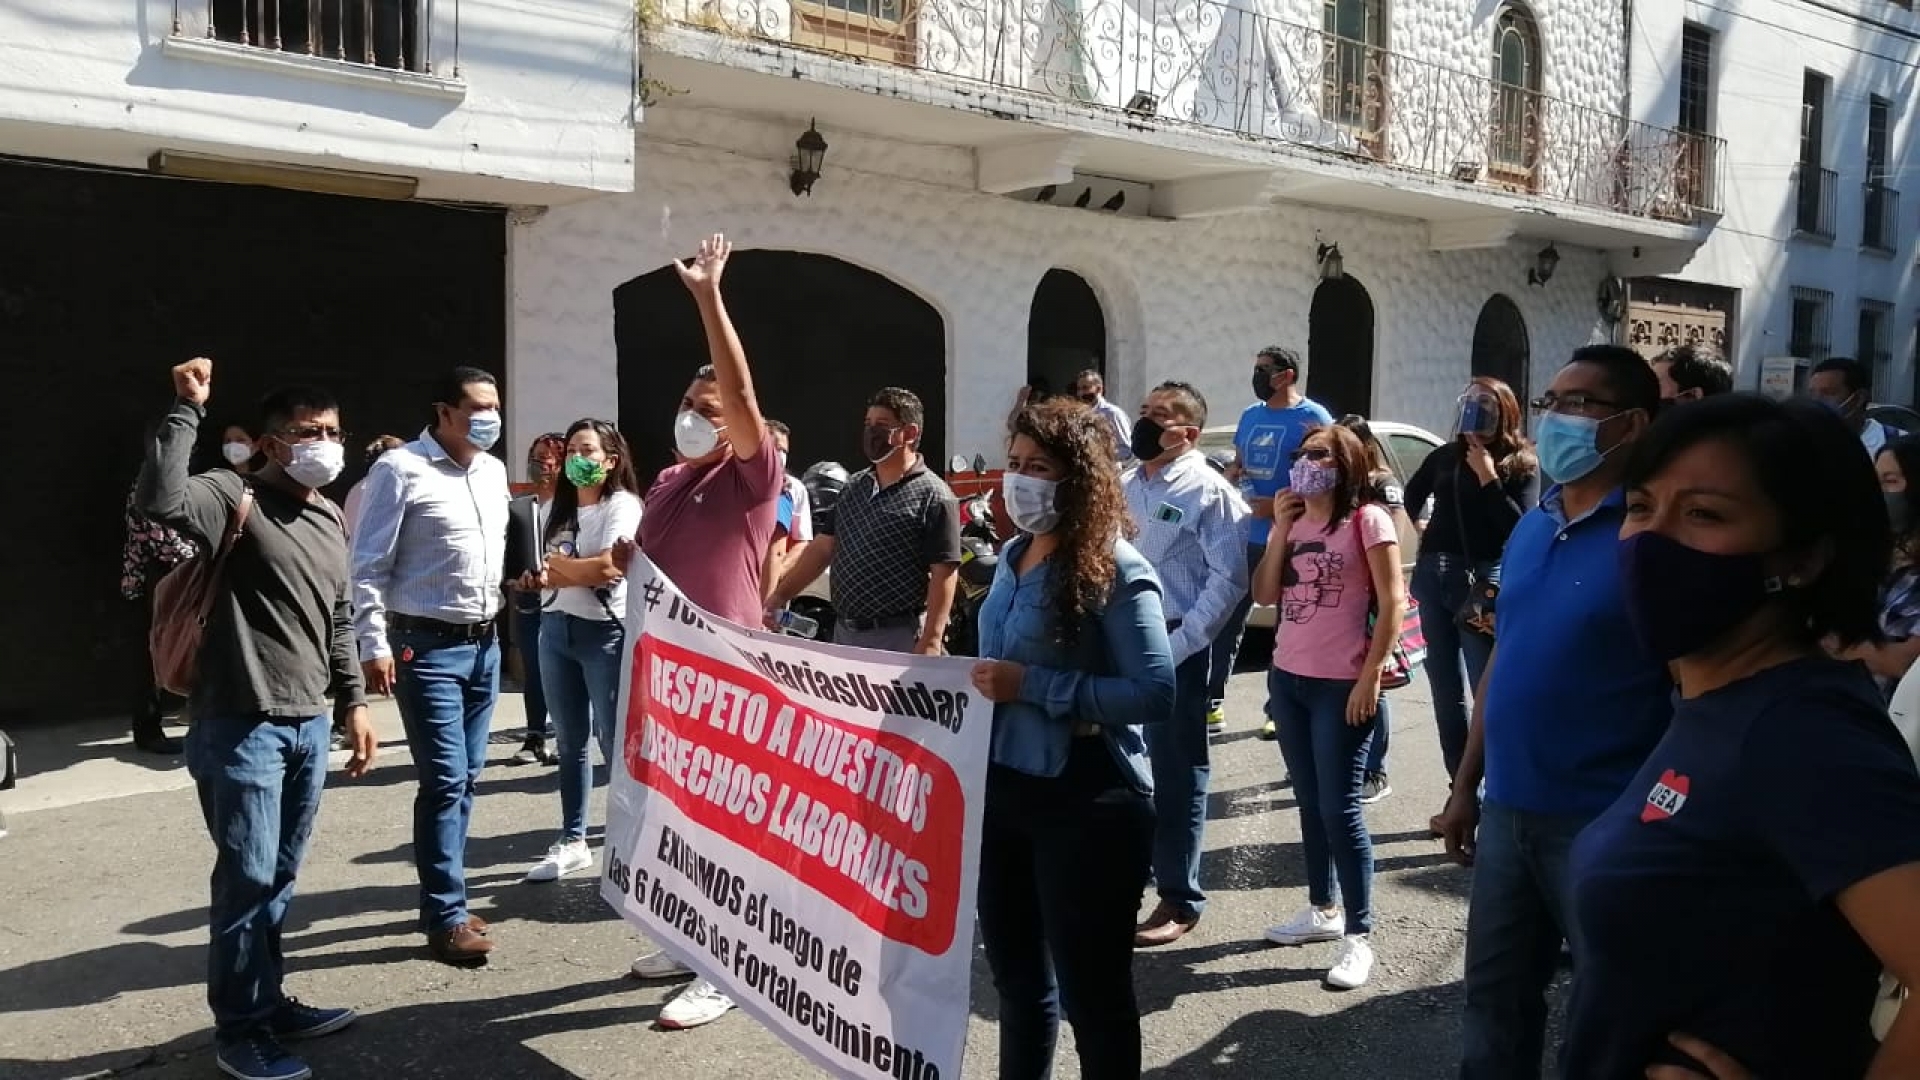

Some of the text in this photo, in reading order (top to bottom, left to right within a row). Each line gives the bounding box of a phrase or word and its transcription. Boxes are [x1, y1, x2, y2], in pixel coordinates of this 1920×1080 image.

[639, 714, 930, 919] DERECHOS LABORALES
[650, 653, 933, 832] RESPETO A NUESTROS
[1649, 786, 1678, 812] USA
[608, 847, 941, 1080] las 6 horas de Fortalecimiento
[657, 825, 862, 997] EXIGIMOS el pago de
